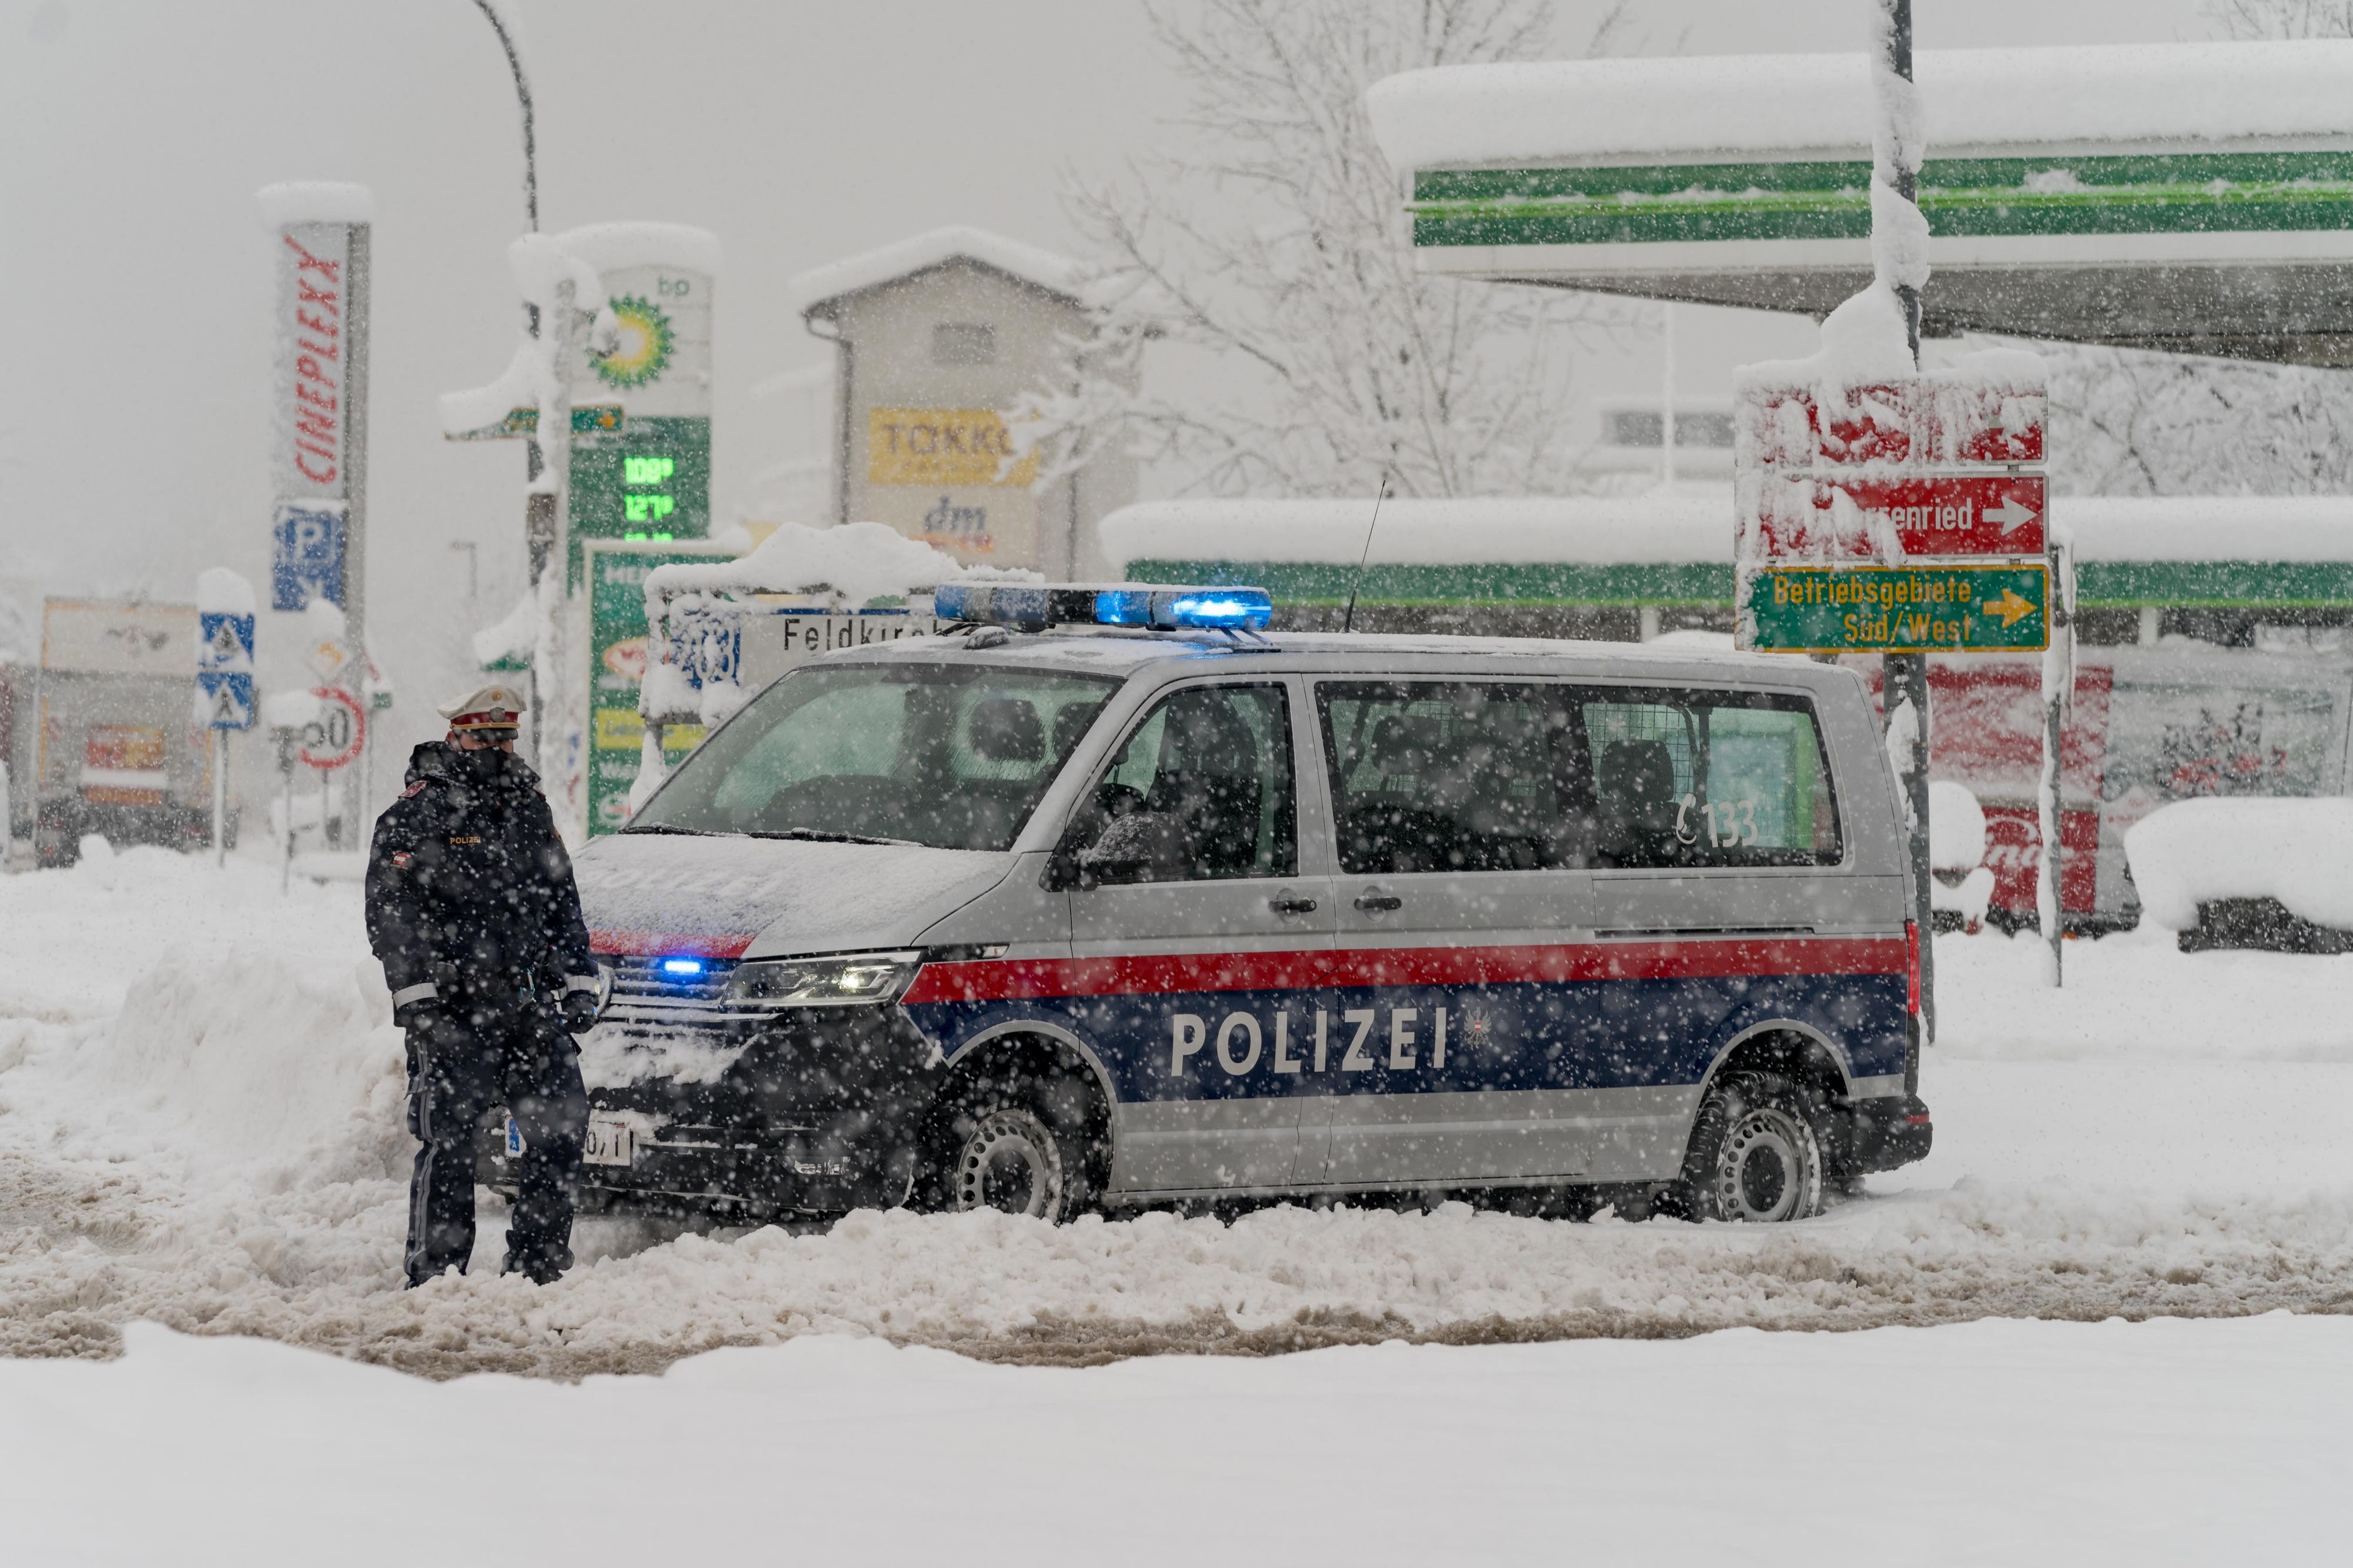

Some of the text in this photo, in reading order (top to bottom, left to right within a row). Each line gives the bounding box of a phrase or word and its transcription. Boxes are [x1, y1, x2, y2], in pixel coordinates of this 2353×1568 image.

[658, 276, 691, 298] bp
[284, 234, 339, 485] CINEPLEXX
[924, 497, 987, 531] dm
[1774, 575, 1972, 609] Betriebsgebiete
[1844, 611, 1971, 642] Süd/West
[449, 836, 482, 845] POLIZEI
[1701, 799, 1759, 848] 133
[1171, 1007, 1447, 1077] POLIZEI
